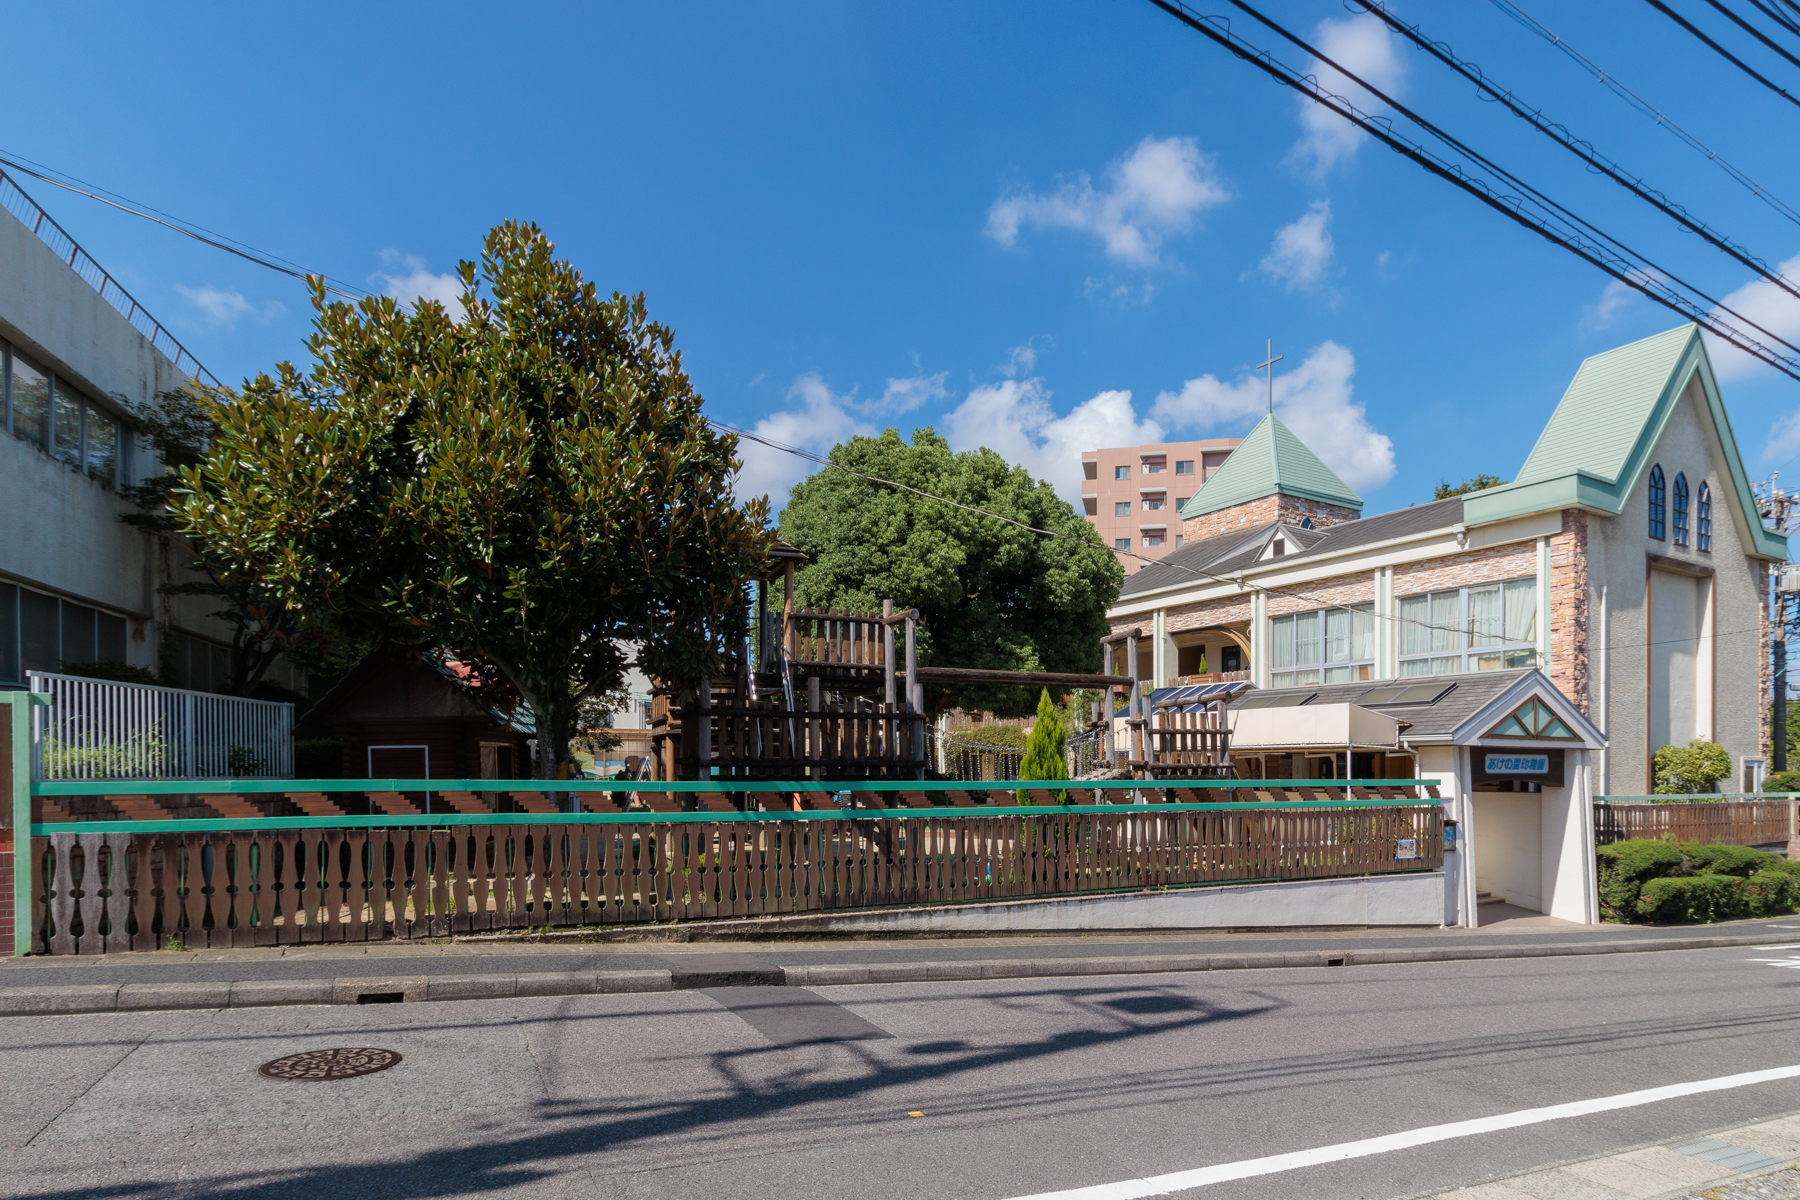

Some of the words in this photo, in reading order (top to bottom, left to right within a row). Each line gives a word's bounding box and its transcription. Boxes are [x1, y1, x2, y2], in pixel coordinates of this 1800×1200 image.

[1487, 758, 1546, 770] あけの星幼稚園
